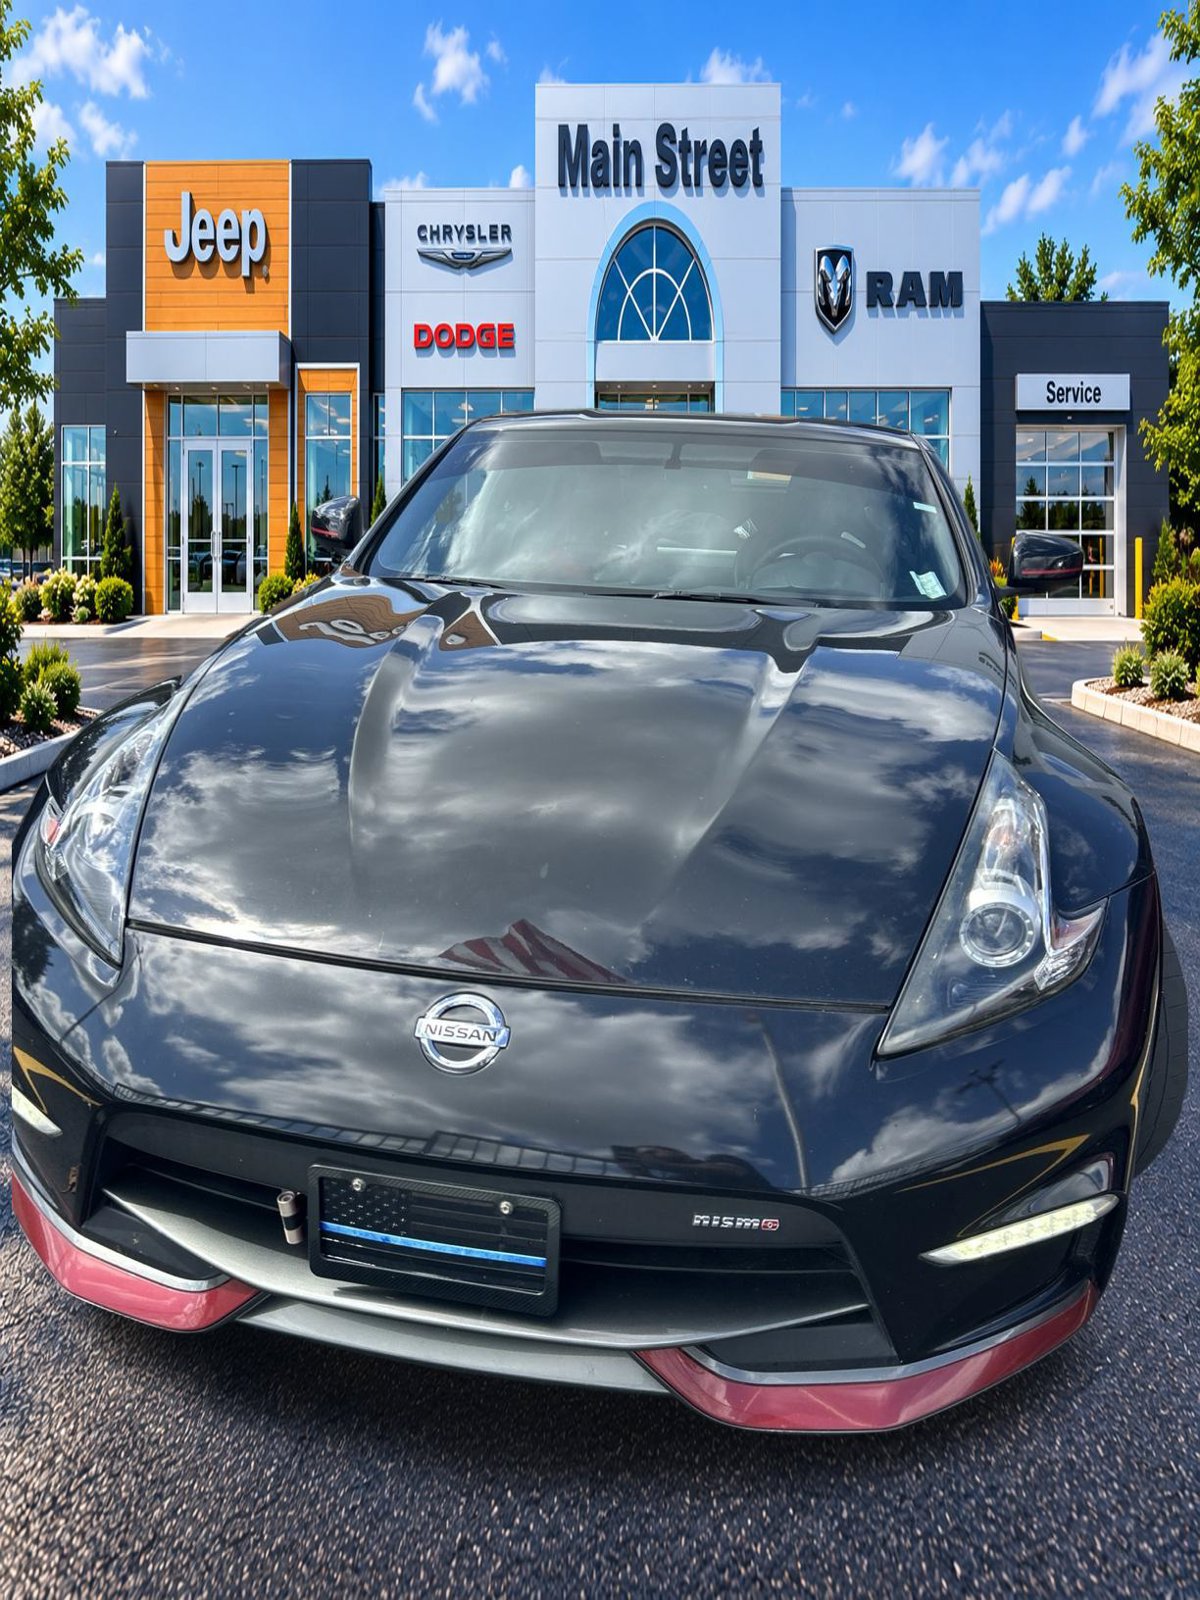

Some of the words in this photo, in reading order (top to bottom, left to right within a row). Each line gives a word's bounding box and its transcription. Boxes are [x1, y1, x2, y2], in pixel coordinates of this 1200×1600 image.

[558, 123, 643, 188] Main
[655, 123, 764, 188] Street
[164, 191, 267, 277] Jeep
[417, 224, 512, 242] CHRYSLER
[866, 271, 964, 308] RAM
[414, 323, 515, 349] DODGE
[1046, 380, 1102, 404] Service
[424, 1023, 497, 1042] NISSAN
